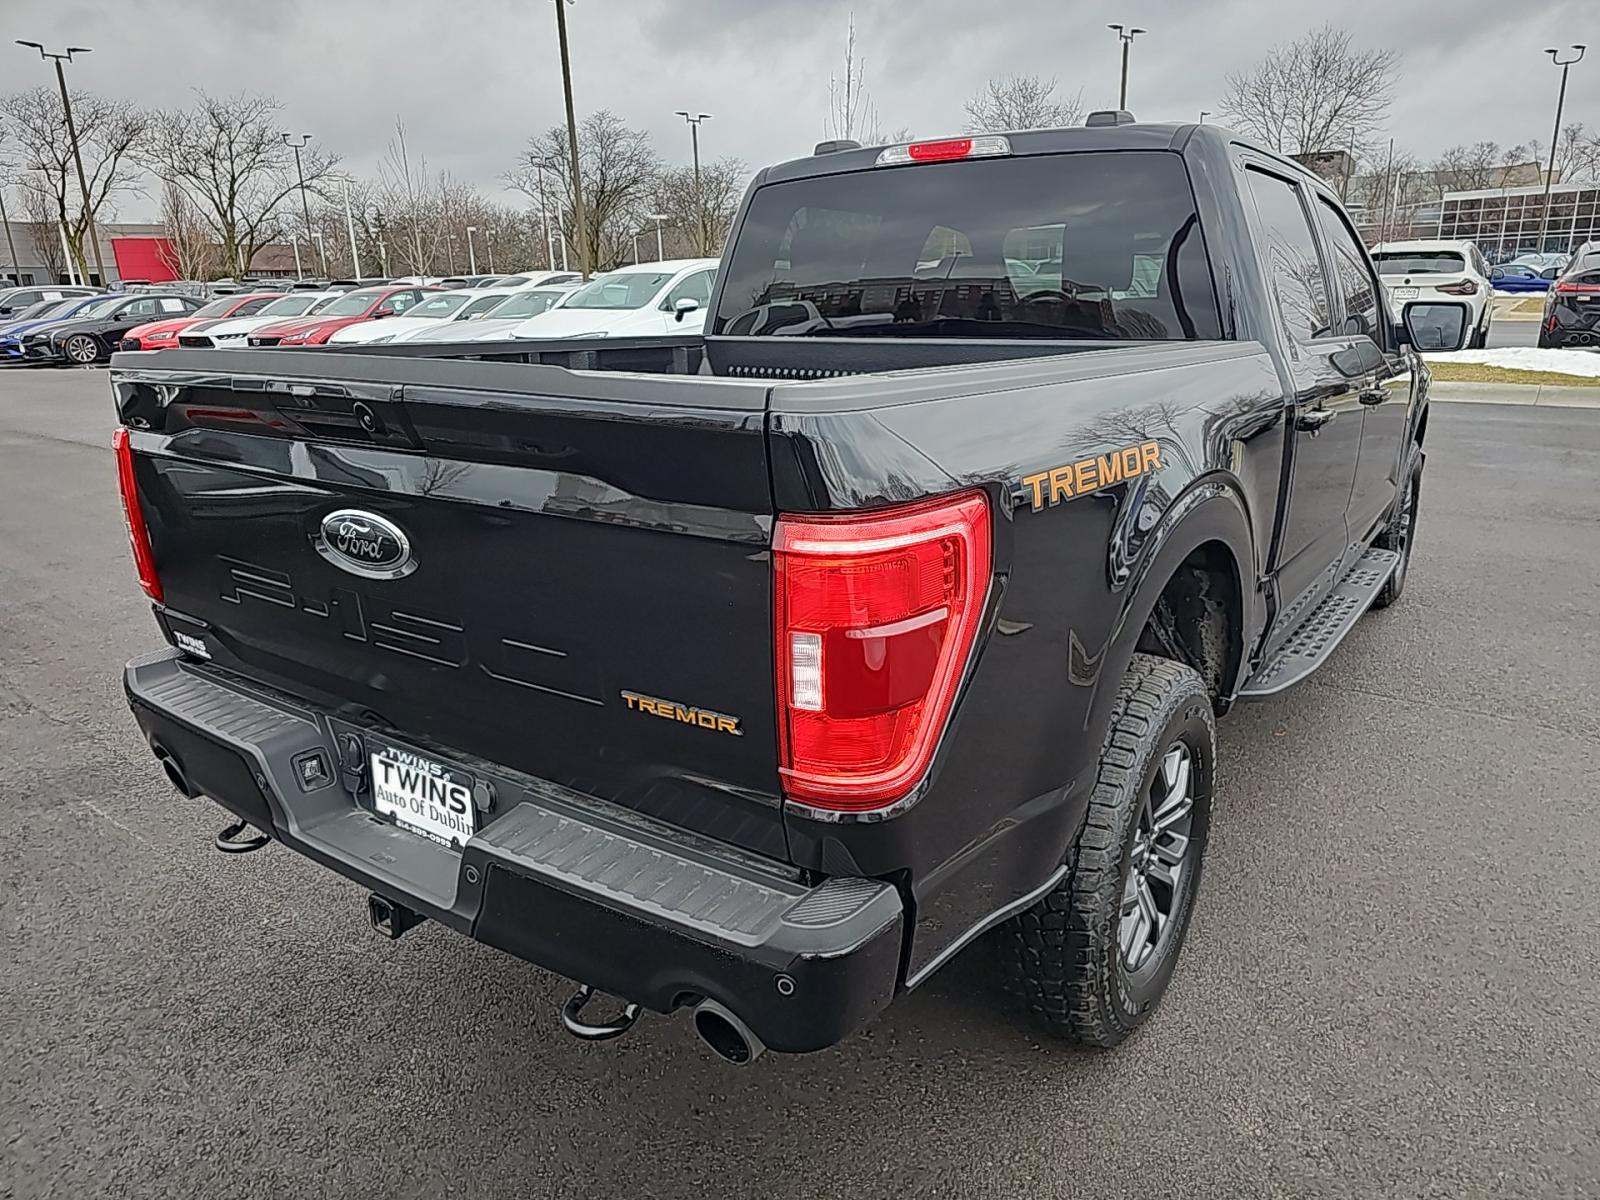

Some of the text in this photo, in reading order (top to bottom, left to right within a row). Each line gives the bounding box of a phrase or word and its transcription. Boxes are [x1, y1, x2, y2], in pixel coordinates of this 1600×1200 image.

[1022, 440, 1163, 511] TREMOR
[337, 521, 383, 559] Ford
[620, 689, 743, 736] TREMOR
[387, 747, 442, 776] TWINS
[376, 784, 407, 809] Auto
[410, 797, 425, 817] Of
[379, 758, 467, 815] TWINS
